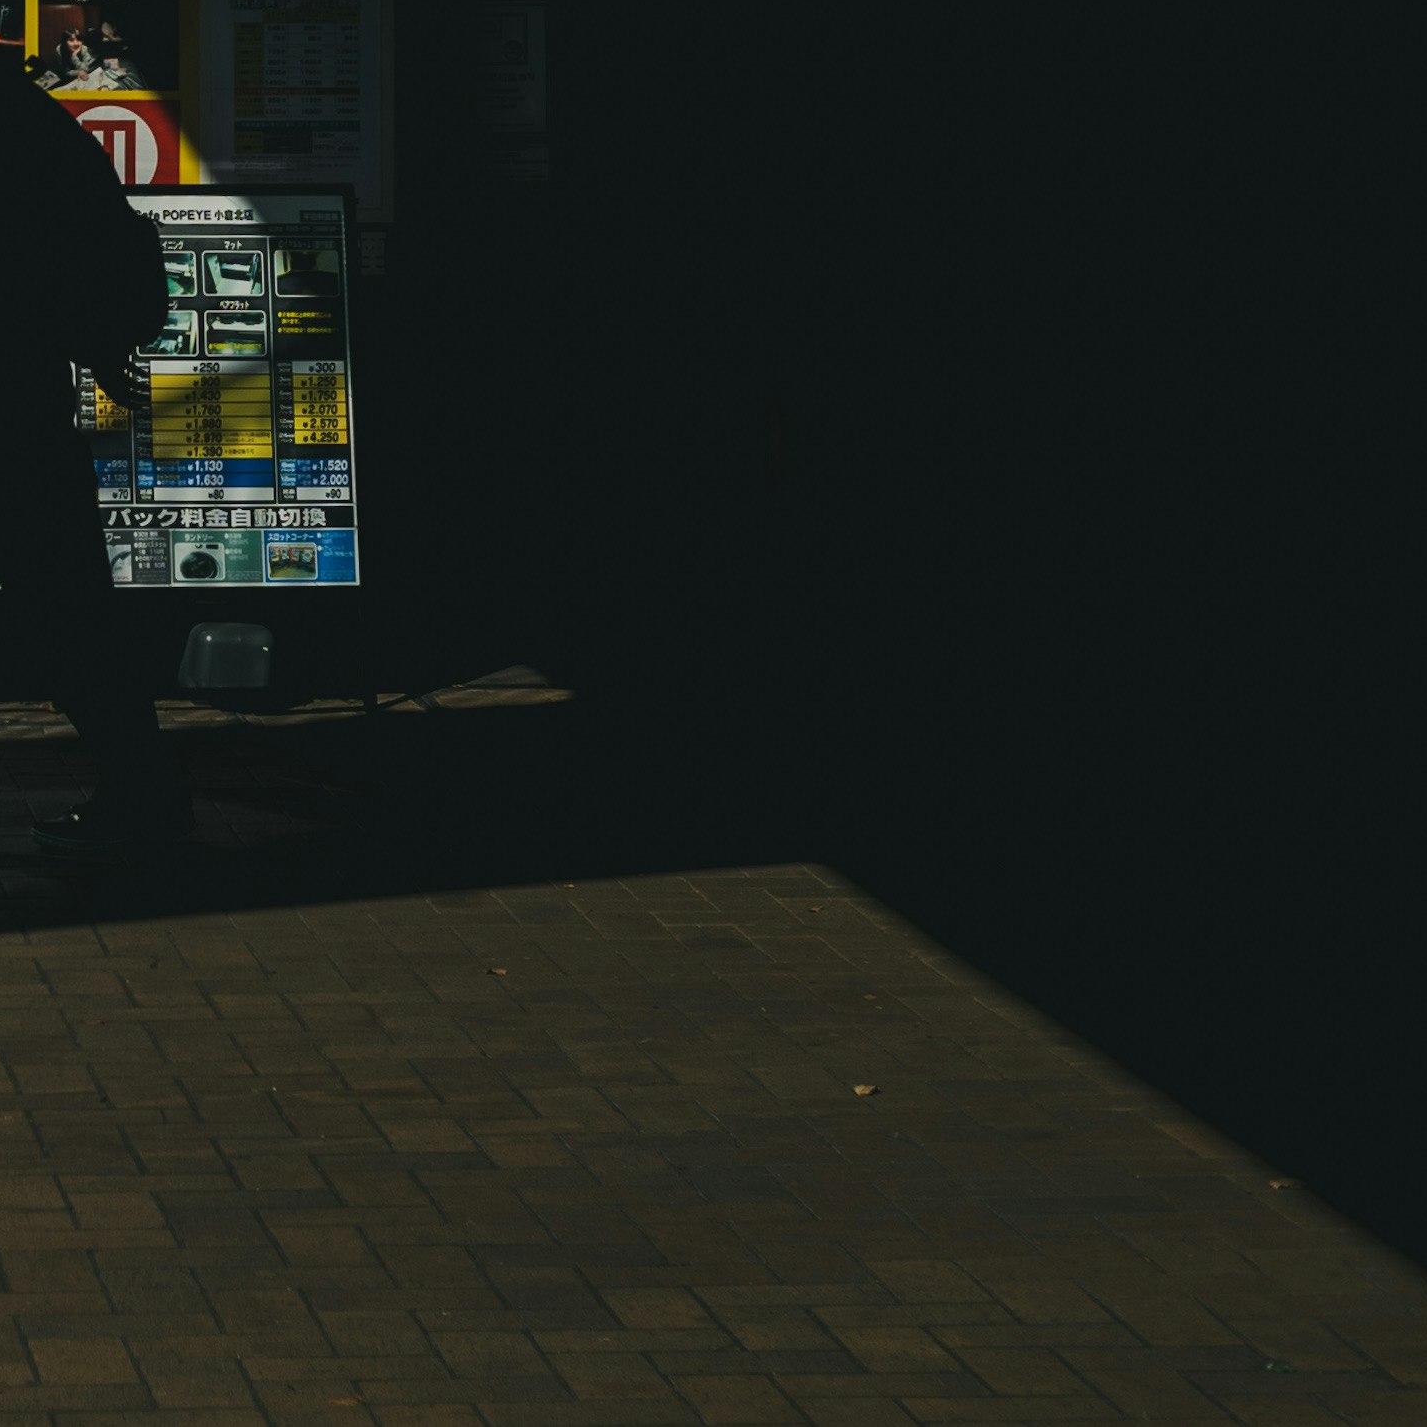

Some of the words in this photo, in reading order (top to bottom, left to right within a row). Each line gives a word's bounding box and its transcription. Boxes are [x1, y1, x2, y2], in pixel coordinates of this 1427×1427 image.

[163, 210, 211, 220] POPEYE
[107, 508, 327, 529] パック料金自動切換
